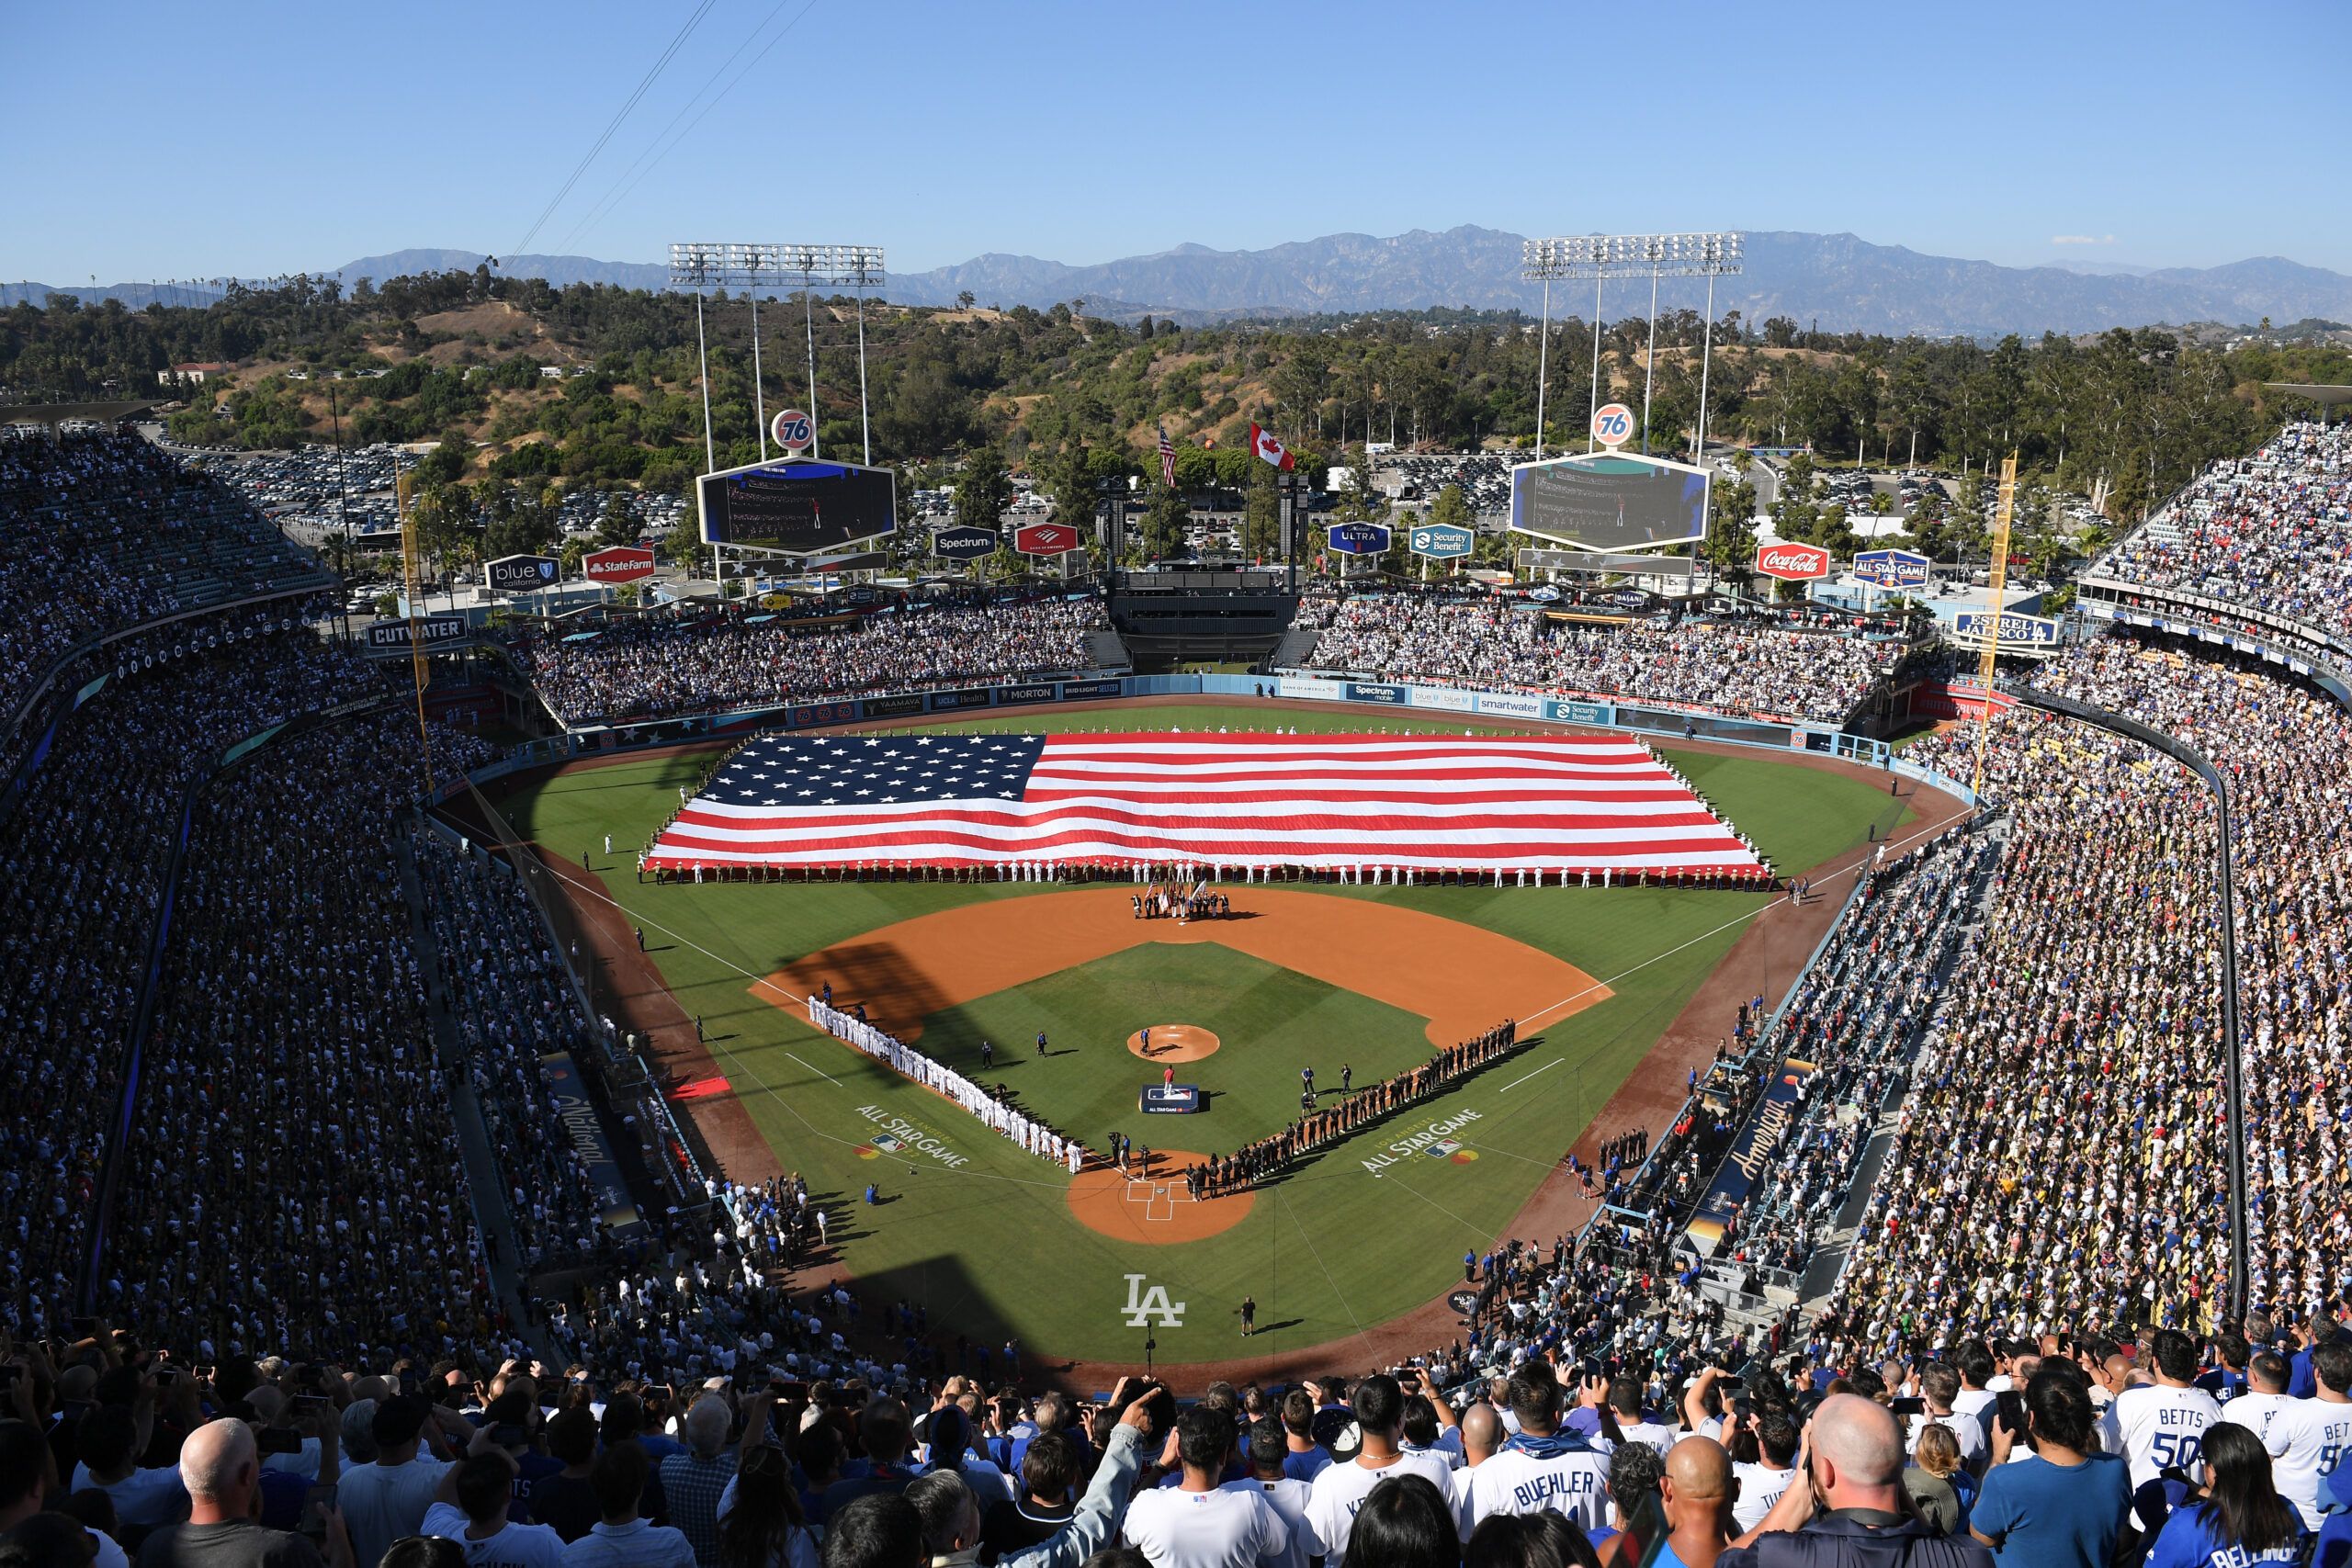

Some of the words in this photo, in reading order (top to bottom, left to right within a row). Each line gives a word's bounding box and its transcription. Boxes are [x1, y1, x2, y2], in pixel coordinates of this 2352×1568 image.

[782, 418, 810, 442] 76
[1599, 413, 1627, 436] 76
[1342, 532, 1375, 541] ULTRA
[1433, 532, 1466, 542] Security
[940, 538, 988, 549] Spectrum
[1433, 542, 1463, 551] Benefit
[496, 564, 535, 581] blue
[1857, 561, 1871, 572] ALL
[1875, 562, 1896, 574] STAR
[1896, 565, 1926, 577] GAME
[503, 578, 541, 587] california
[1617, 594, 1643, 604] DASANI
[2139, 586, 2199, 604] DODGER
[2208, 600, 2267, 622] STADIUM
[375, 621, 459, 643] CUTWATER
[1012, 688, 1051, 699] MORTON
[1356, 685, 1393, 695] Spectrum
[938, 697, 956, 705] UCLA
[960, 694, 985, 705] Health
[1444, 694, 1460, 703] blue
[839, 706, 851, 716] 76
[1482, 700, 1538, 713] smartwater
[1572, 706, 1599, 716] Security
[798, 711, 809, 721] 76
[819, 708, 830, 718] 76
[1572, 713, 1595, 722] Benefit
[602, 736, 613, 744] 76
[1793, 735, 1804, 743] 76
[854, 1105, 889, 1122] ALL
[880, 1118, 923, 1143] STAR
[917, 1138, 969, 1168] GAME
[1361, 1153, 1398, 1173] ALL
[1390, 1132, 1438, 1156] STAR
[1429, 1109, 1484, 1135] GAME
[1731, 1099, 1795, 1181] American
[1121, 1274, 1185, 1327] LA
[2159, 1408, 2204, 1427] BETTS
[2151, 1431, 2201, 1470] 50
[1514, 1471, 1594, 1507] BUEHLER
